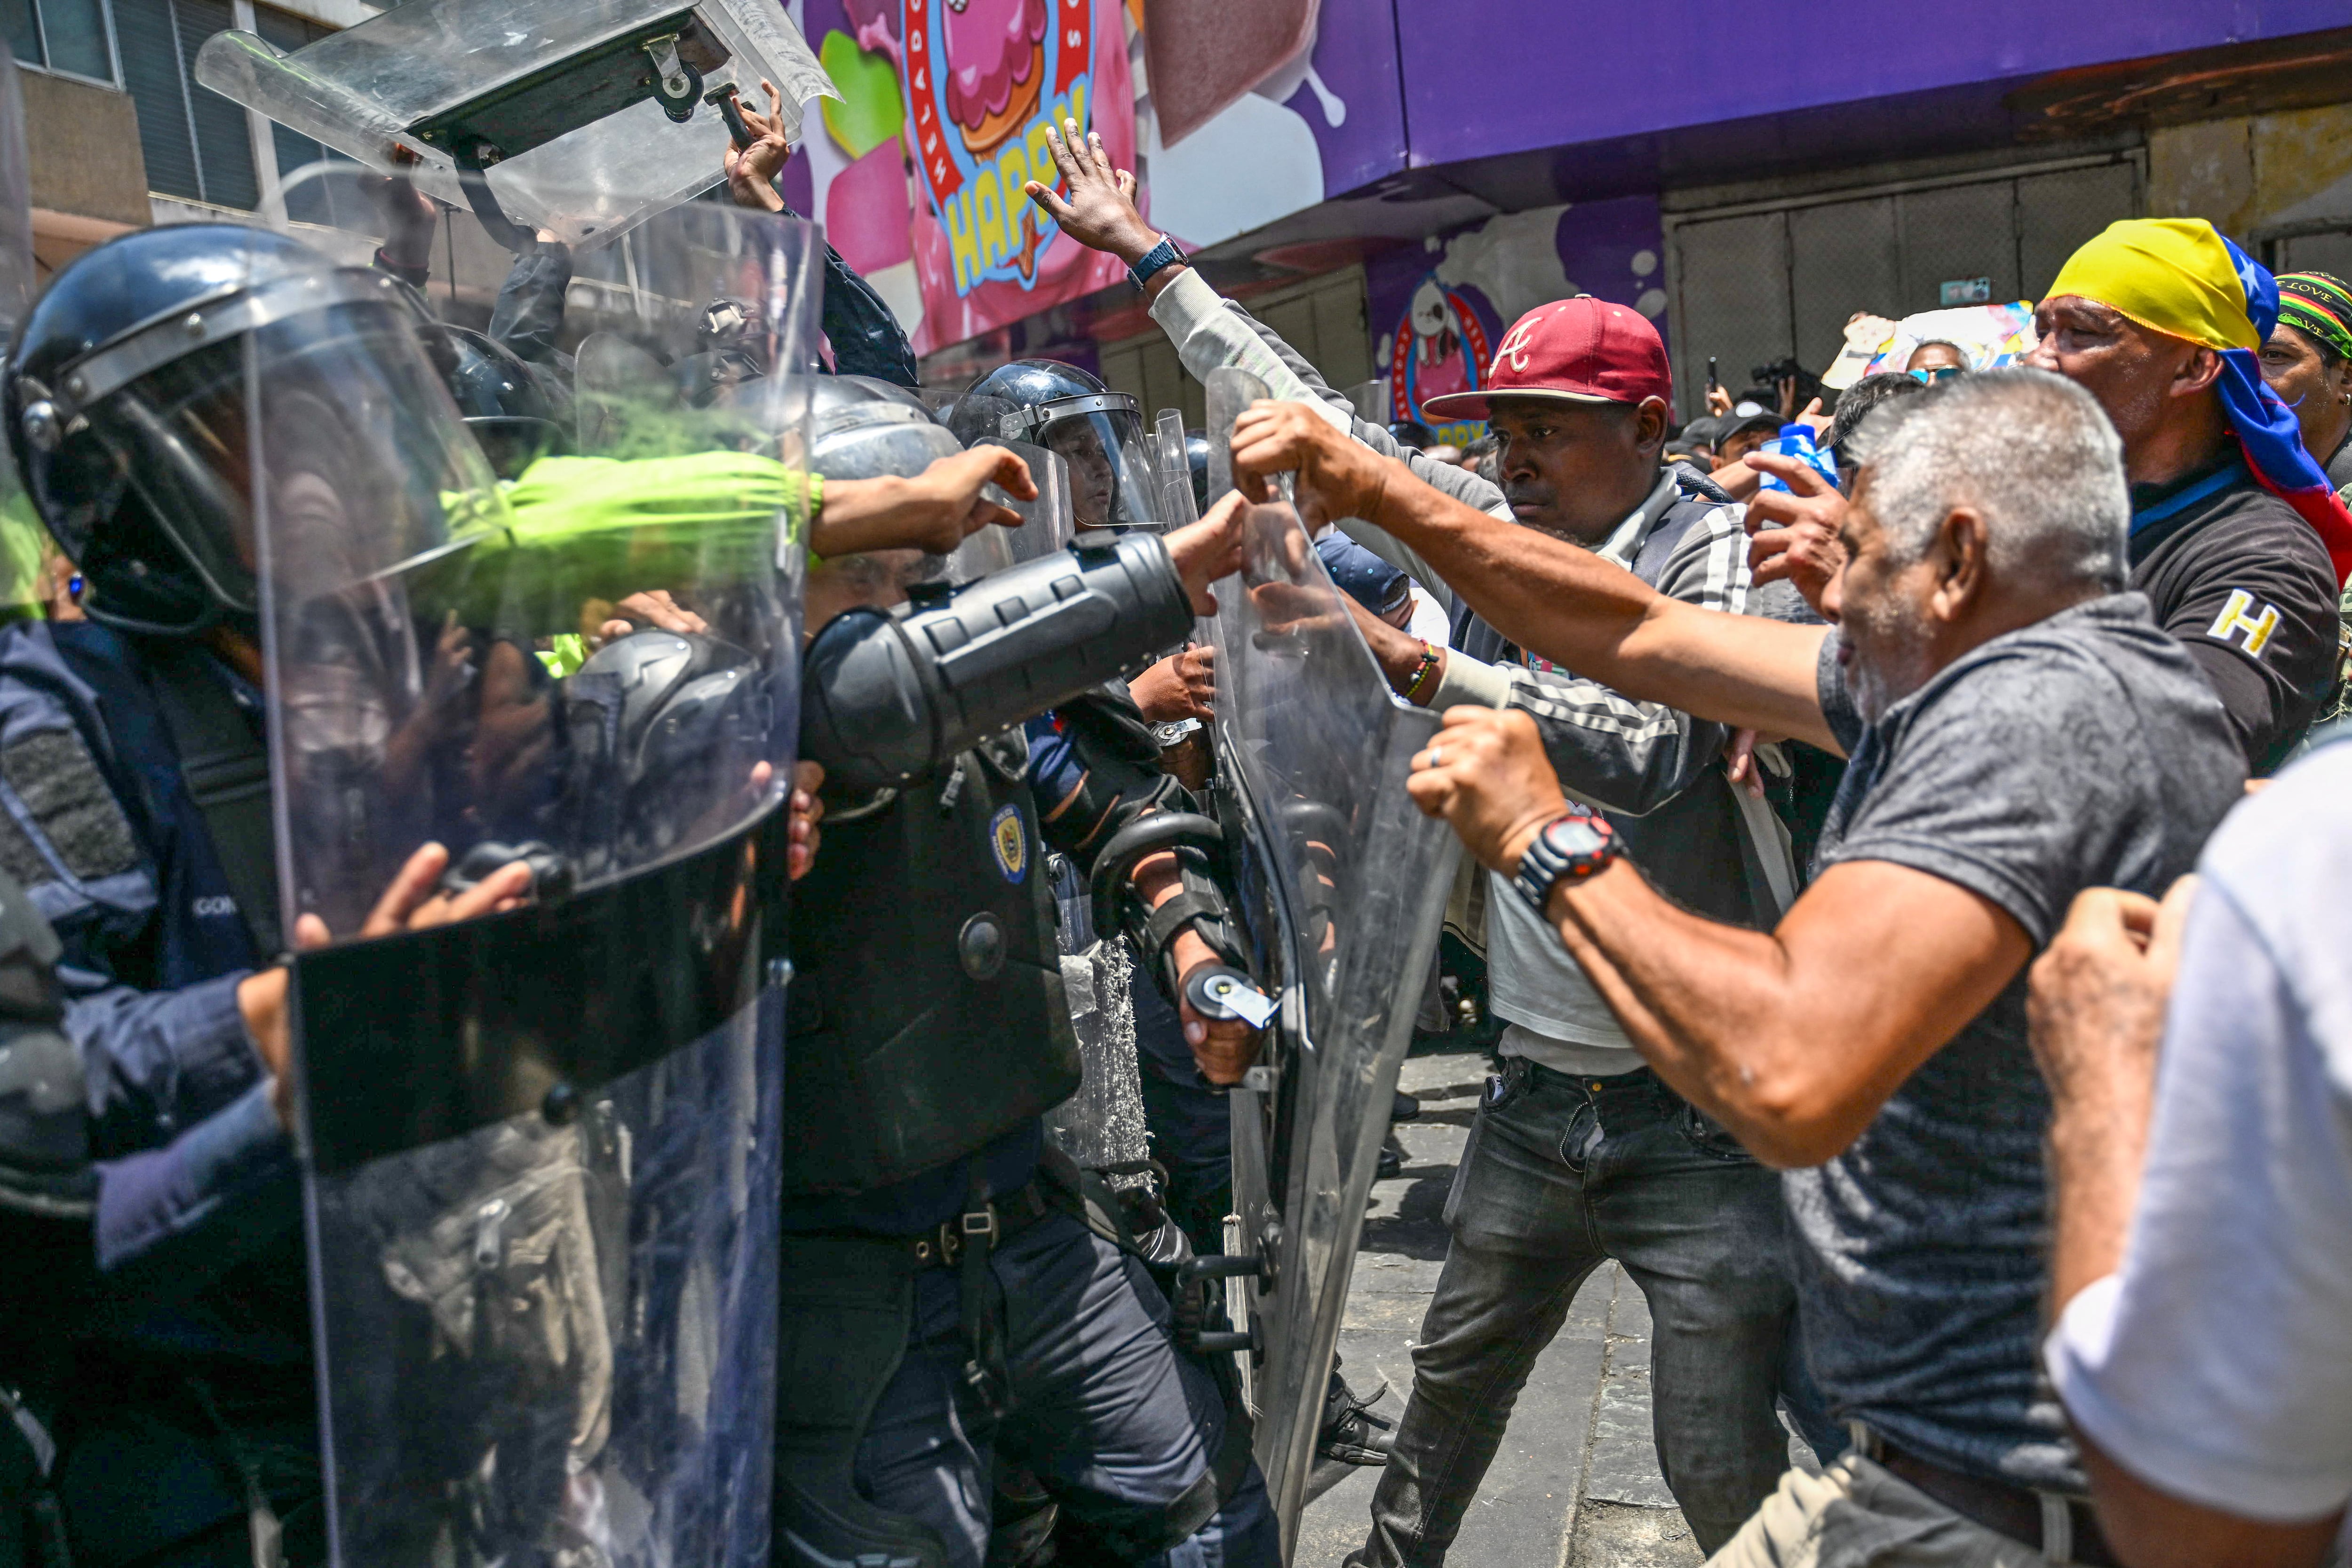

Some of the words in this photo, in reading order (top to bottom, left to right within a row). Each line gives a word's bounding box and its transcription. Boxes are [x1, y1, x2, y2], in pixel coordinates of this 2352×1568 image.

[947, 85, 1085, 288] HAPPY
[2287, 283, 2332, 302] LOVE
[2299, 271, 2339, 281] LOVE
[1489, 317, 1543, 379] A
[1438, 422, 1486, 450] PPY
[2207, 588, 2281, 658] H
